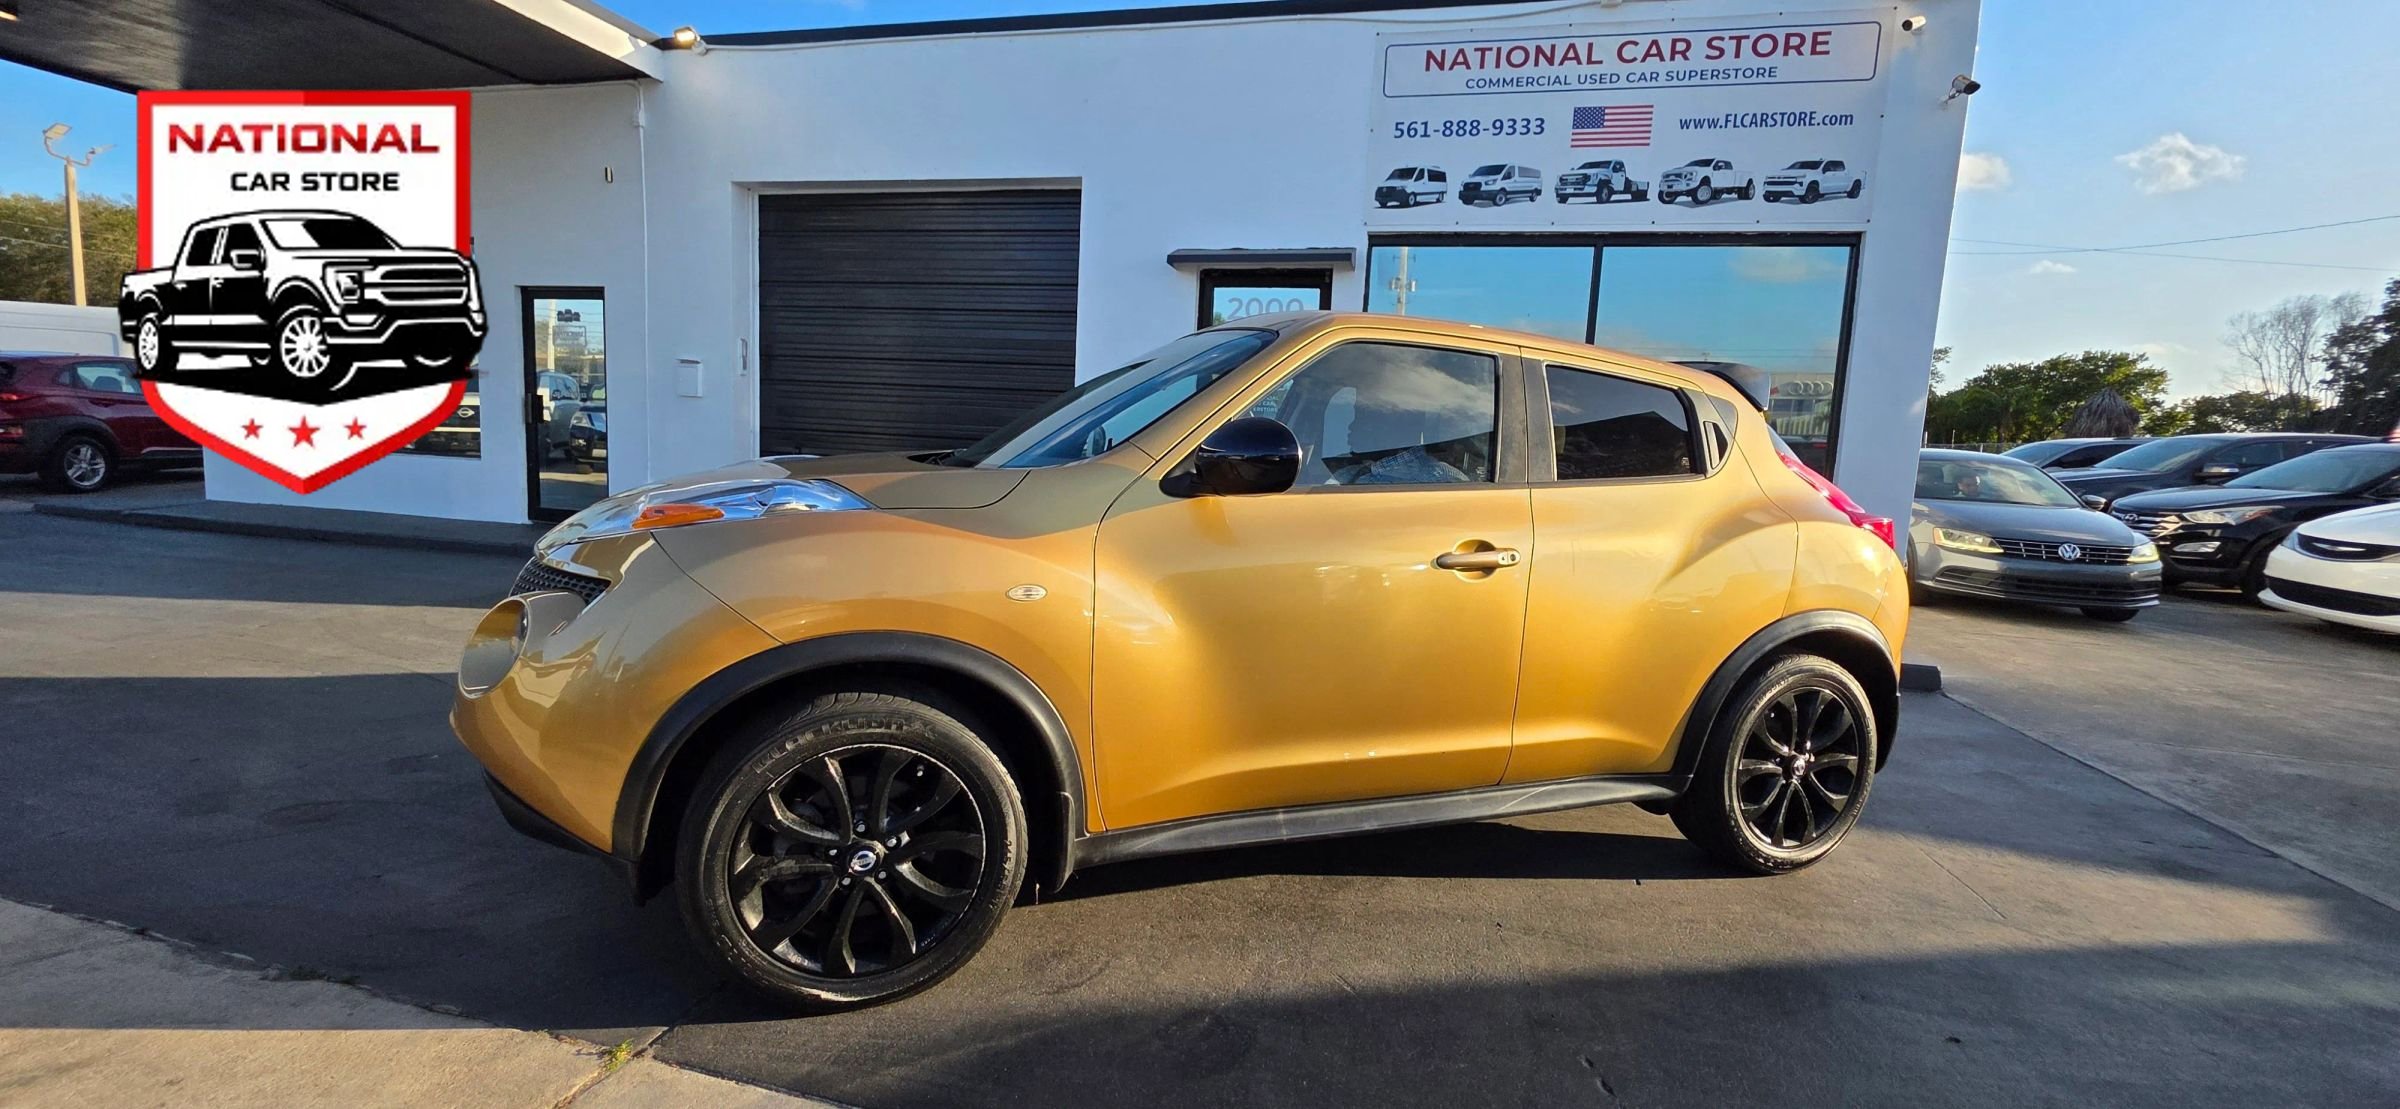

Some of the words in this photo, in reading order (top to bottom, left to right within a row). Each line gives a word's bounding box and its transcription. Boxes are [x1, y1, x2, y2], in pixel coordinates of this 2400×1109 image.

[1424, 42, 1604, 72] NATIONAL
[1616, 37, 1692, 64] CAR
[1704, 31, 1832, 60] STORE
[1465, 75, 1572, 89] COMMERCIAL
[1577, 73, 1620, 85] USED
[1626, 71, 1660, 84] CAR
[1665, 66, 1778, 81] SUPERSTORE
[1393, 117, 1546, 139] 561-888-9333
[1679, 111, 1854, 130] www.FLCARSTORE.com
[1228, 298, 1303, 318] 2000
